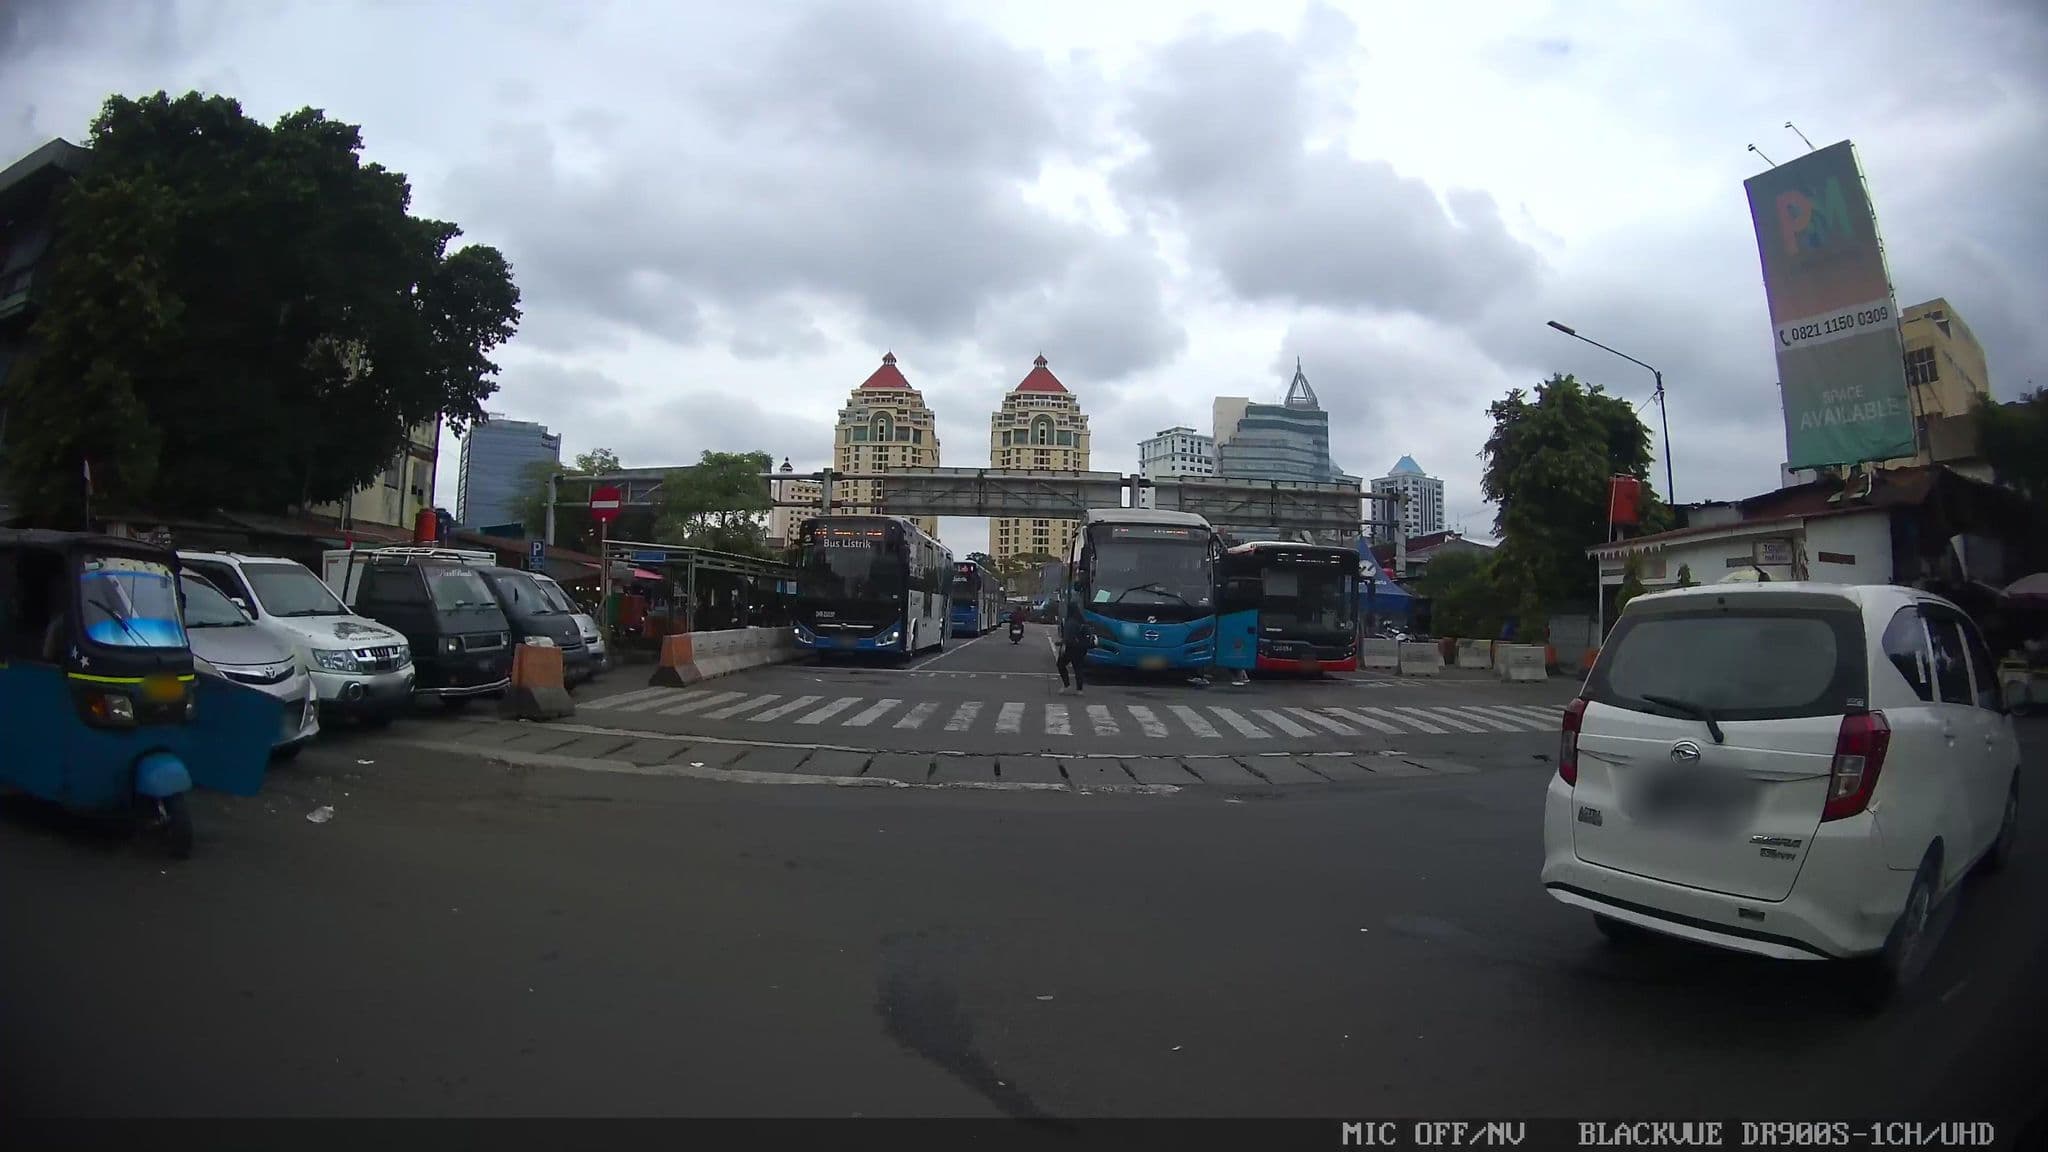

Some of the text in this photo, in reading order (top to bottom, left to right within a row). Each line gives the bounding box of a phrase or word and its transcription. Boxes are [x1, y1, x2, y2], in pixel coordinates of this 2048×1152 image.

[1791, 306, 1888, 341] 0821 1150 0309
[1822, 385, 1864, 404] SPACE
[1800, 397, 1900, 431] AVAILABLE
[533, 542, 542, 556] P
[823, 538, 871, 549] Bus Listrik
